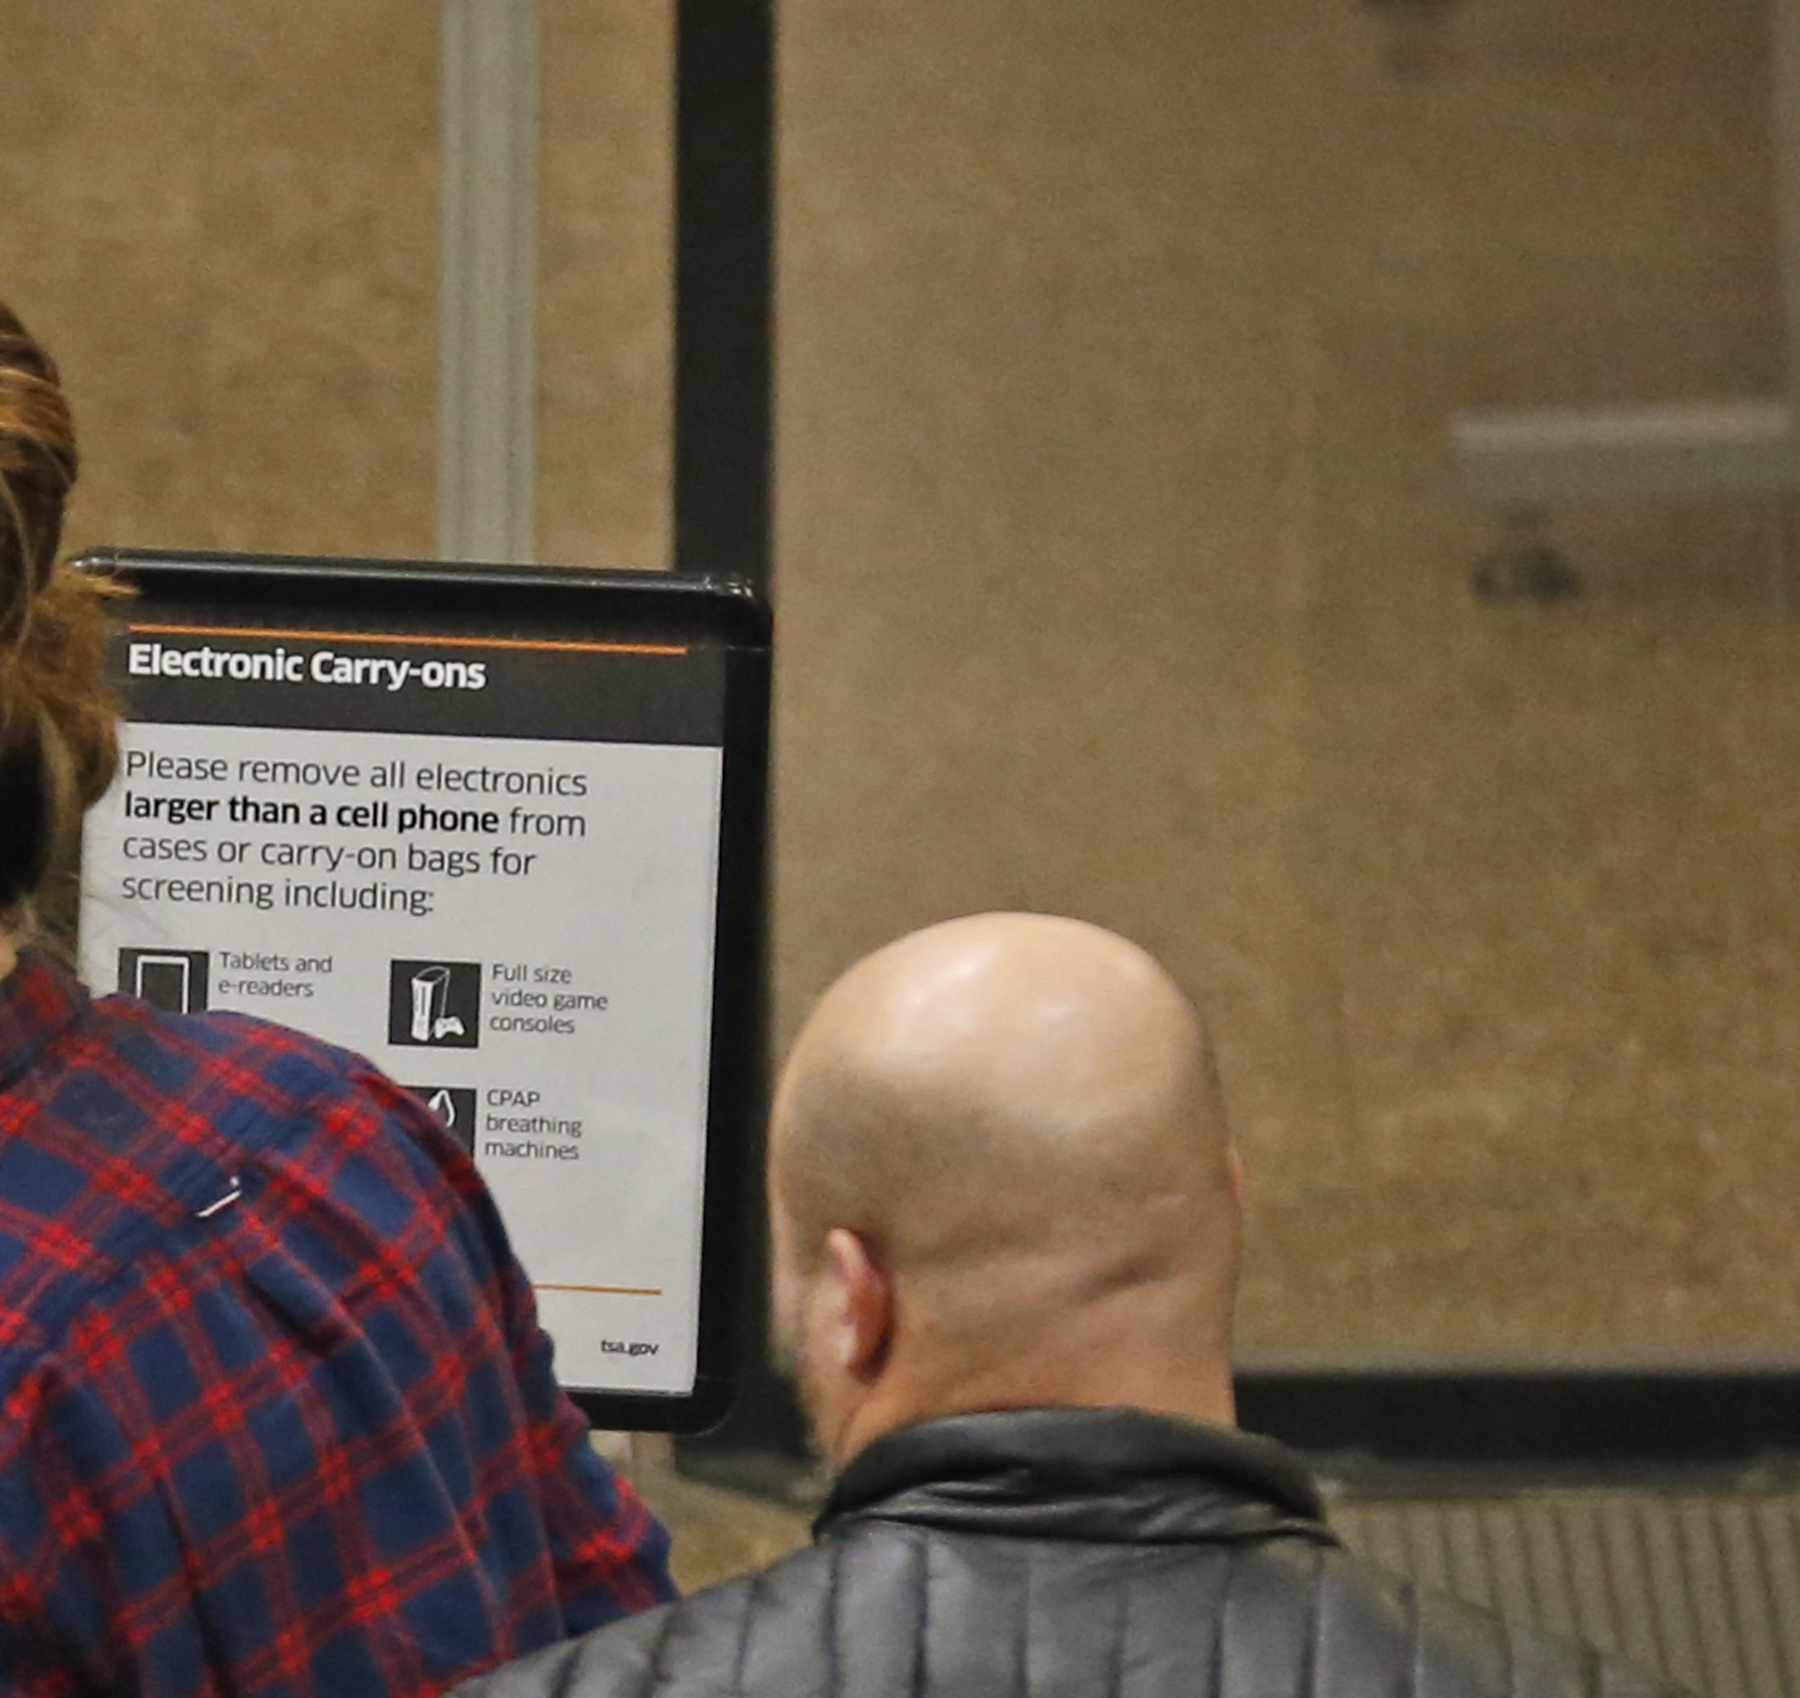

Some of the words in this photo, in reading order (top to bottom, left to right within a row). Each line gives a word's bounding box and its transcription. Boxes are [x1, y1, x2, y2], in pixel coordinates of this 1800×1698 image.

[128, 643, 303, 682] Electronic
[311, 651, 487, 691] Carry-ons
[126, 751, 228, 781] Please
[238, 760, 360, 787] remove
[370, 762, 405, 789] all
[416, 764, 588, 796] electronics
[125, 790, 219, 824] larger
[228, 795, 300, 824] than
[309, 805, 327, 825] a
[336, 802, 388, 828] cell
[397, 803, 499, 834] phone
[509, 807, 586, 836] from
[123, 836, 208, 861] cases
[217, 839, 252, 863] or
[261, 841, 396, 871] carry-on
[407, 843, 480, 877] bags
[491, 847, 537, 875] for
[122, 876, 273, 909] screening
[284, 879, 434, 917] including:
[220, 951, 290, 972] Tablets
[296, 955, 333, 974] and
[491, 963, 527, 982] Full
[533, 966, 573, 985] size
[218, 979, 314, 998] e-readers
[491, 989, 548, 1008] video
[553, 994, 609, 1012] game
[490, 1015, 576, 1034] consoles
[486, 1090, 541, 1108] CPAP
[486, 1114, 583, 1138] breathing
[485, 1140, 580, 1161] machines
[601, 1338, 659, 1357] tsa.gov
